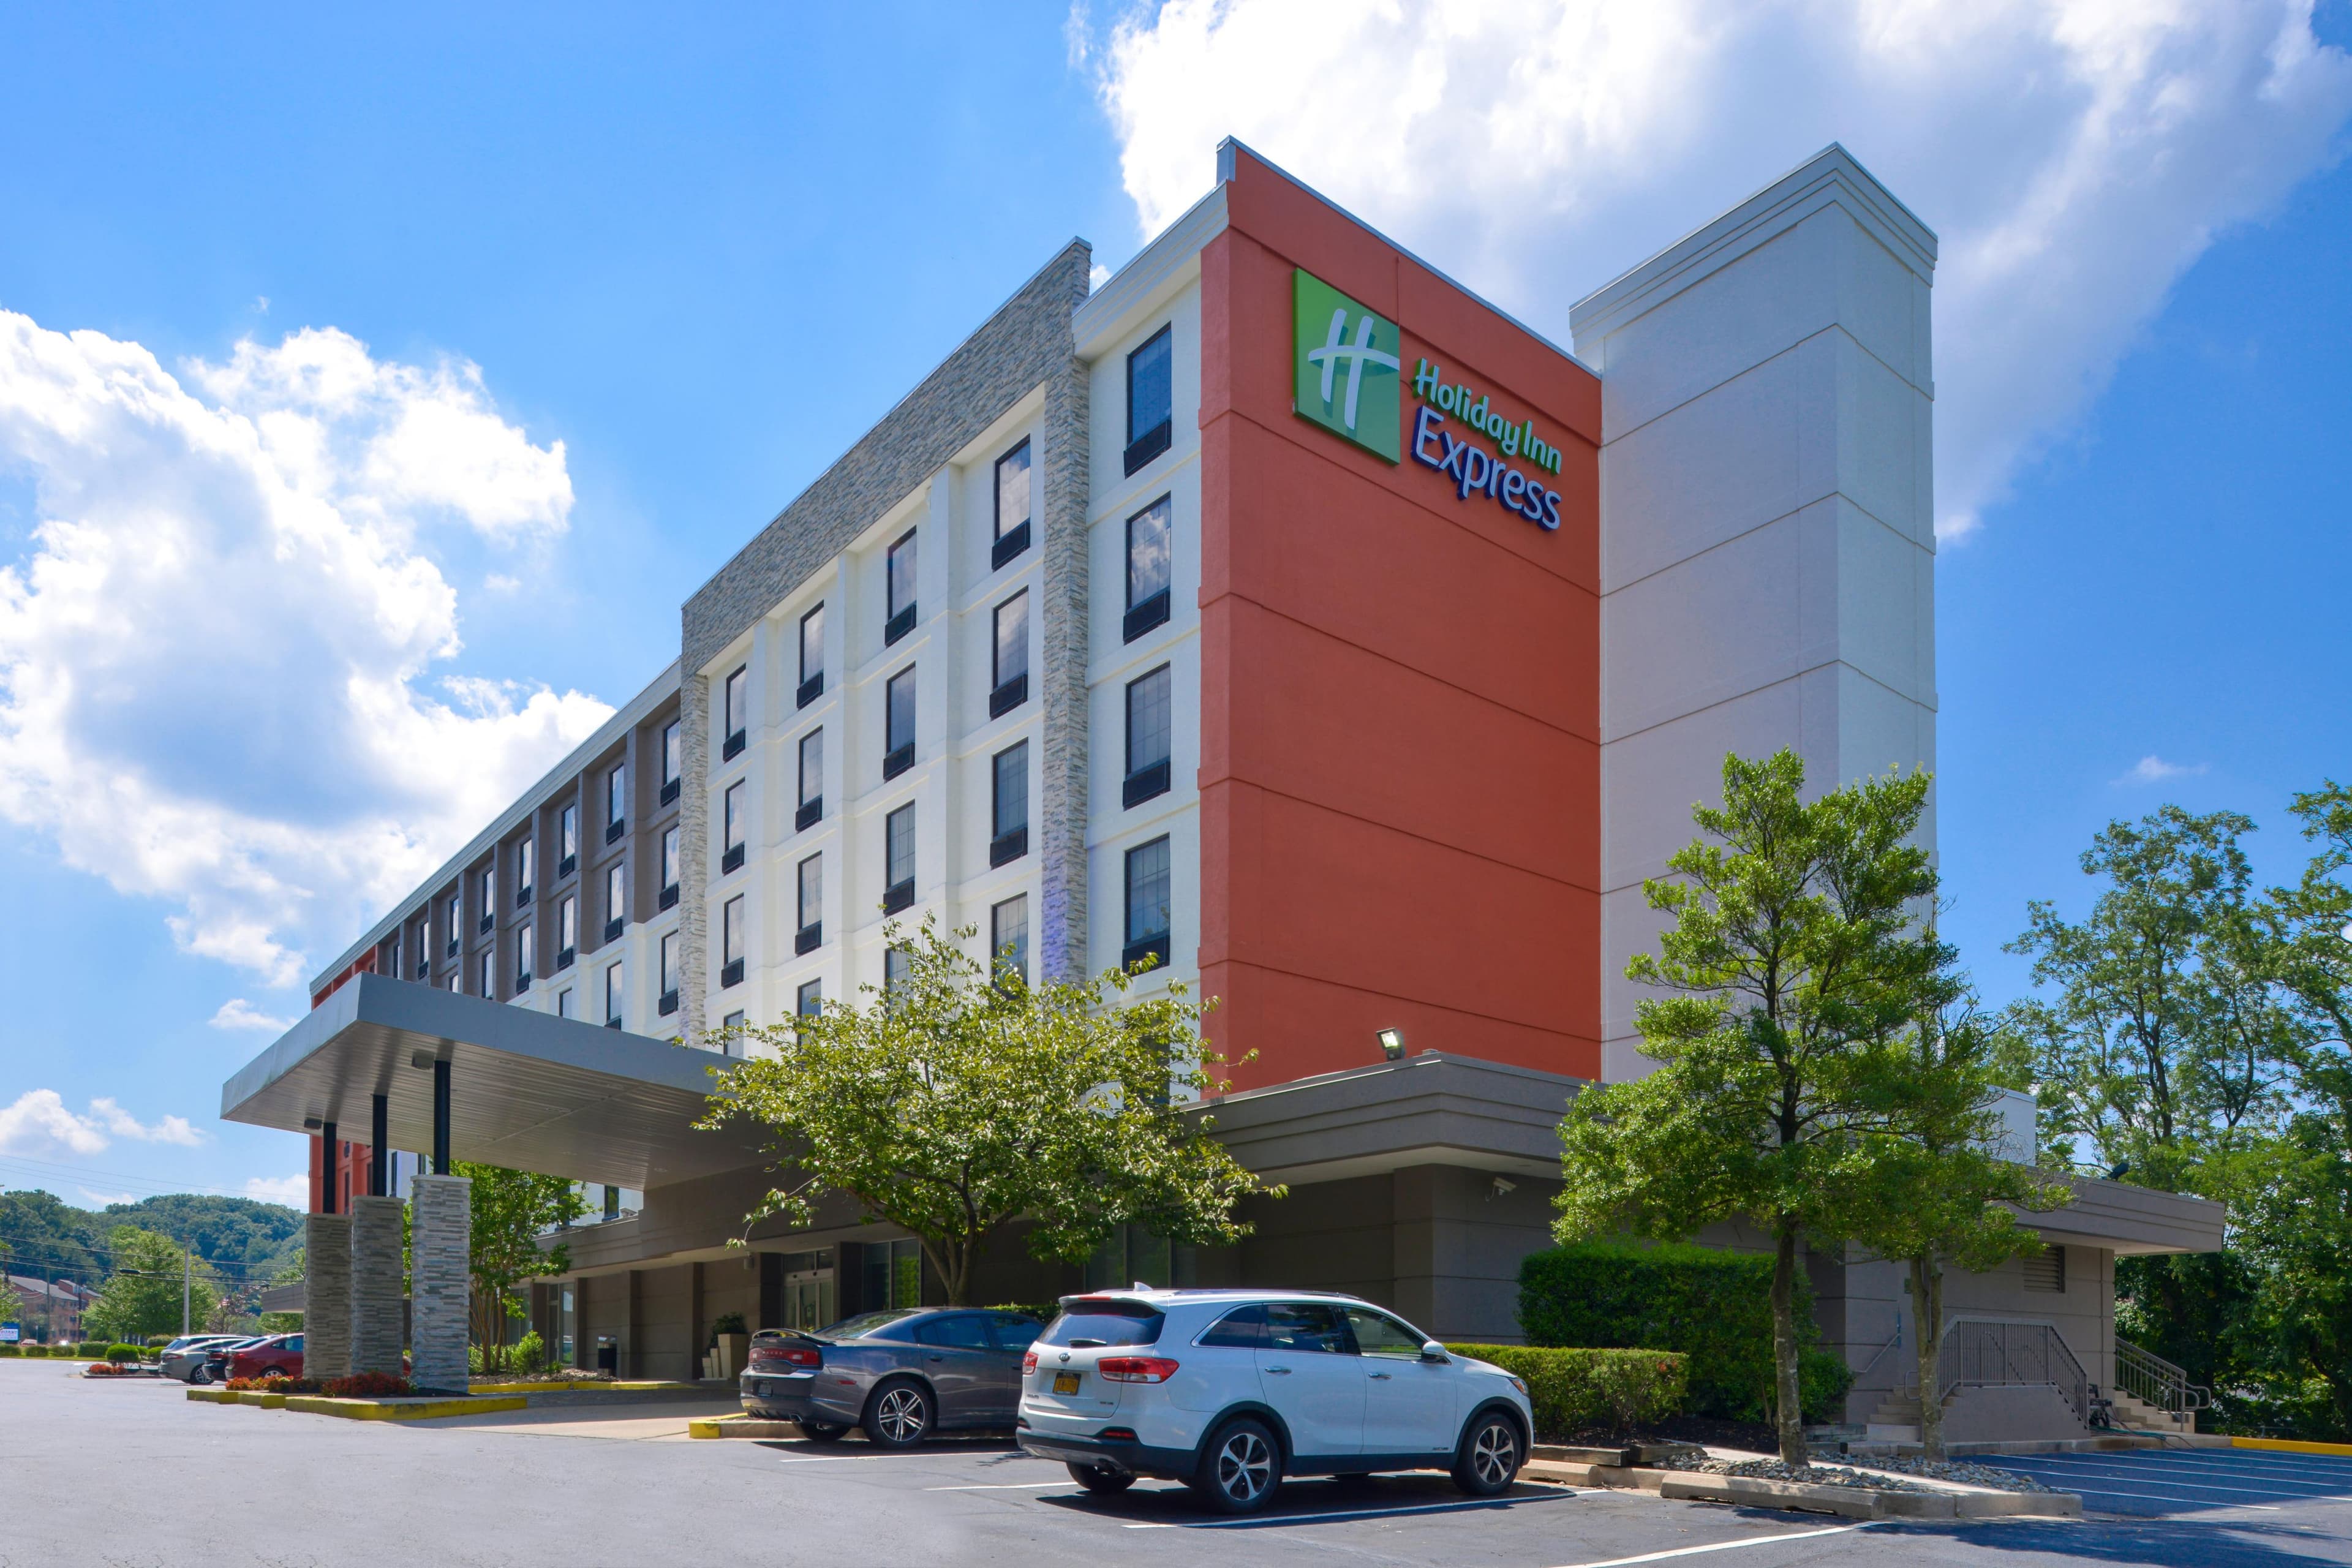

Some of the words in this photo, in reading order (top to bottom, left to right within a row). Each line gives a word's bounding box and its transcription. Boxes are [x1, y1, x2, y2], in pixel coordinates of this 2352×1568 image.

[1411, 405, 1562, 532] Express
[1412, 358, 1521, 456] Holiday
[1521, 420, 1562, 475] Inn
